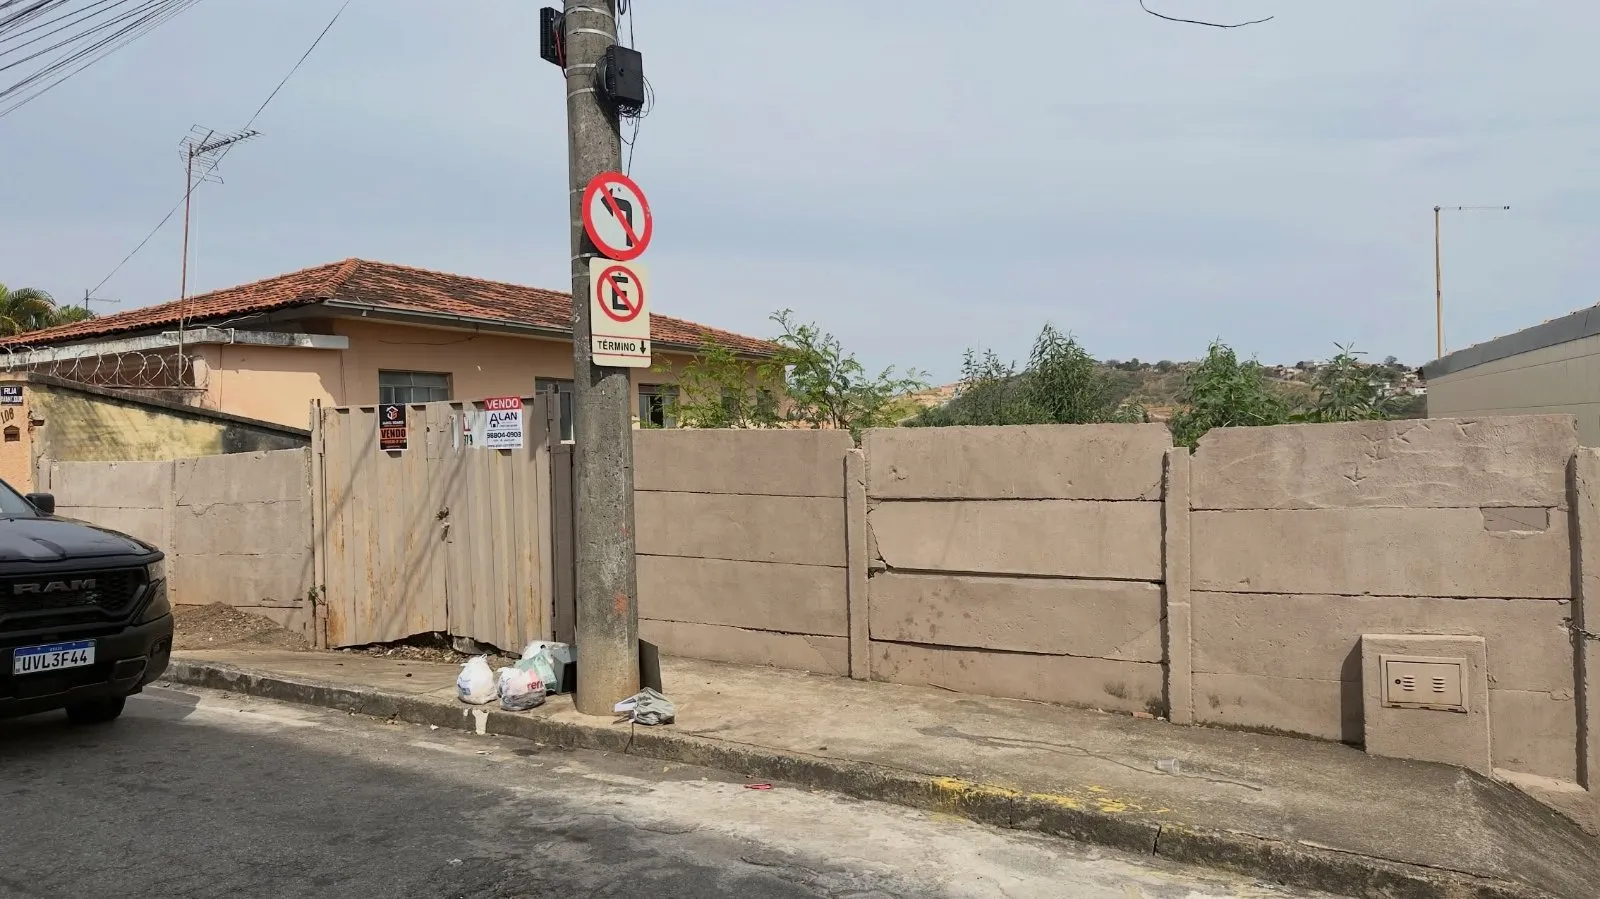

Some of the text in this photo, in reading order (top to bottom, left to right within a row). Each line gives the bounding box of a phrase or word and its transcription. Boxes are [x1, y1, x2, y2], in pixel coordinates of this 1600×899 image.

[597, 339, 636, 352] TÉRMINO
[486, 398, 519, 410] VENDO
[1, 407, 14, 424] 108
[490, 412, 517, 427] ALAN
[380, 428, 406, 438] VENDO
[13, 579, 97, 595] RAM
[22, 650, 87, 671] UVL3F44
